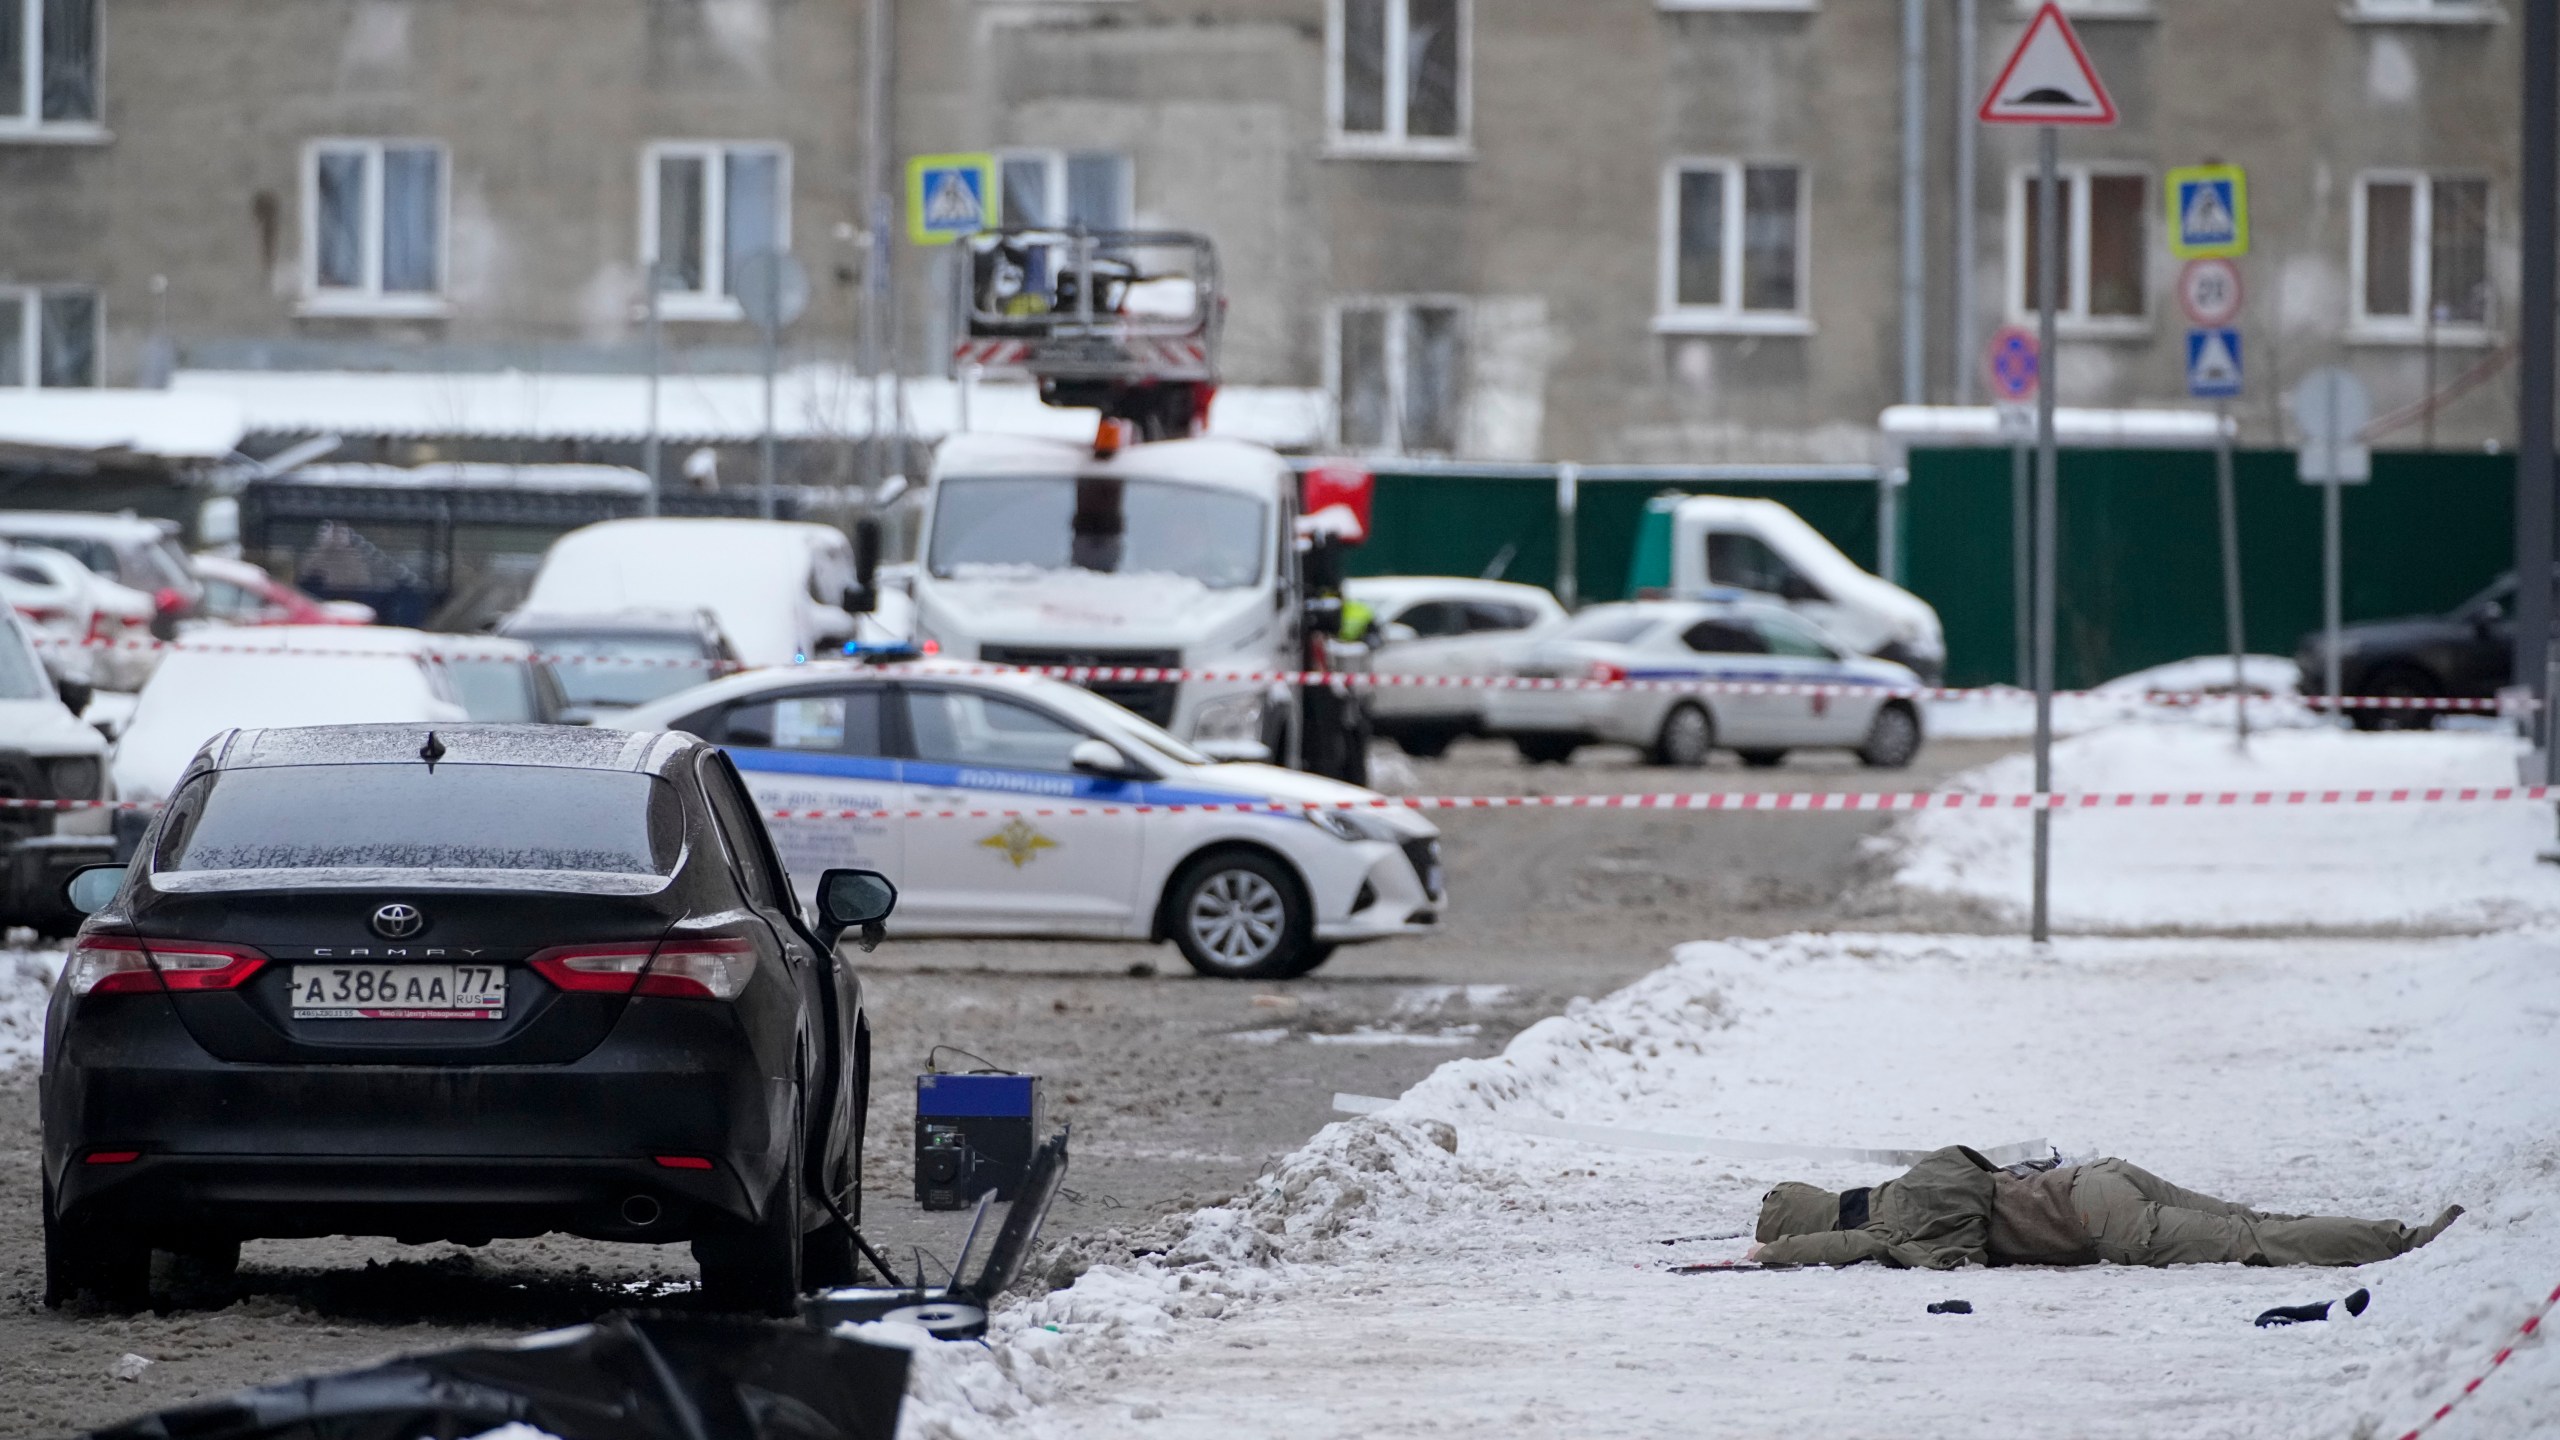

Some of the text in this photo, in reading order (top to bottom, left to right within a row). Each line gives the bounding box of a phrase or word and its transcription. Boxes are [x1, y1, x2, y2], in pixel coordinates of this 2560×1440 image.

[957, 769, 1074, 796] ПОЛИЦИЯ
[458, 967, 492, 993] 77
[457, 994, 481, 1003] RUS
[404, 1010, 426, 1018] Центр
